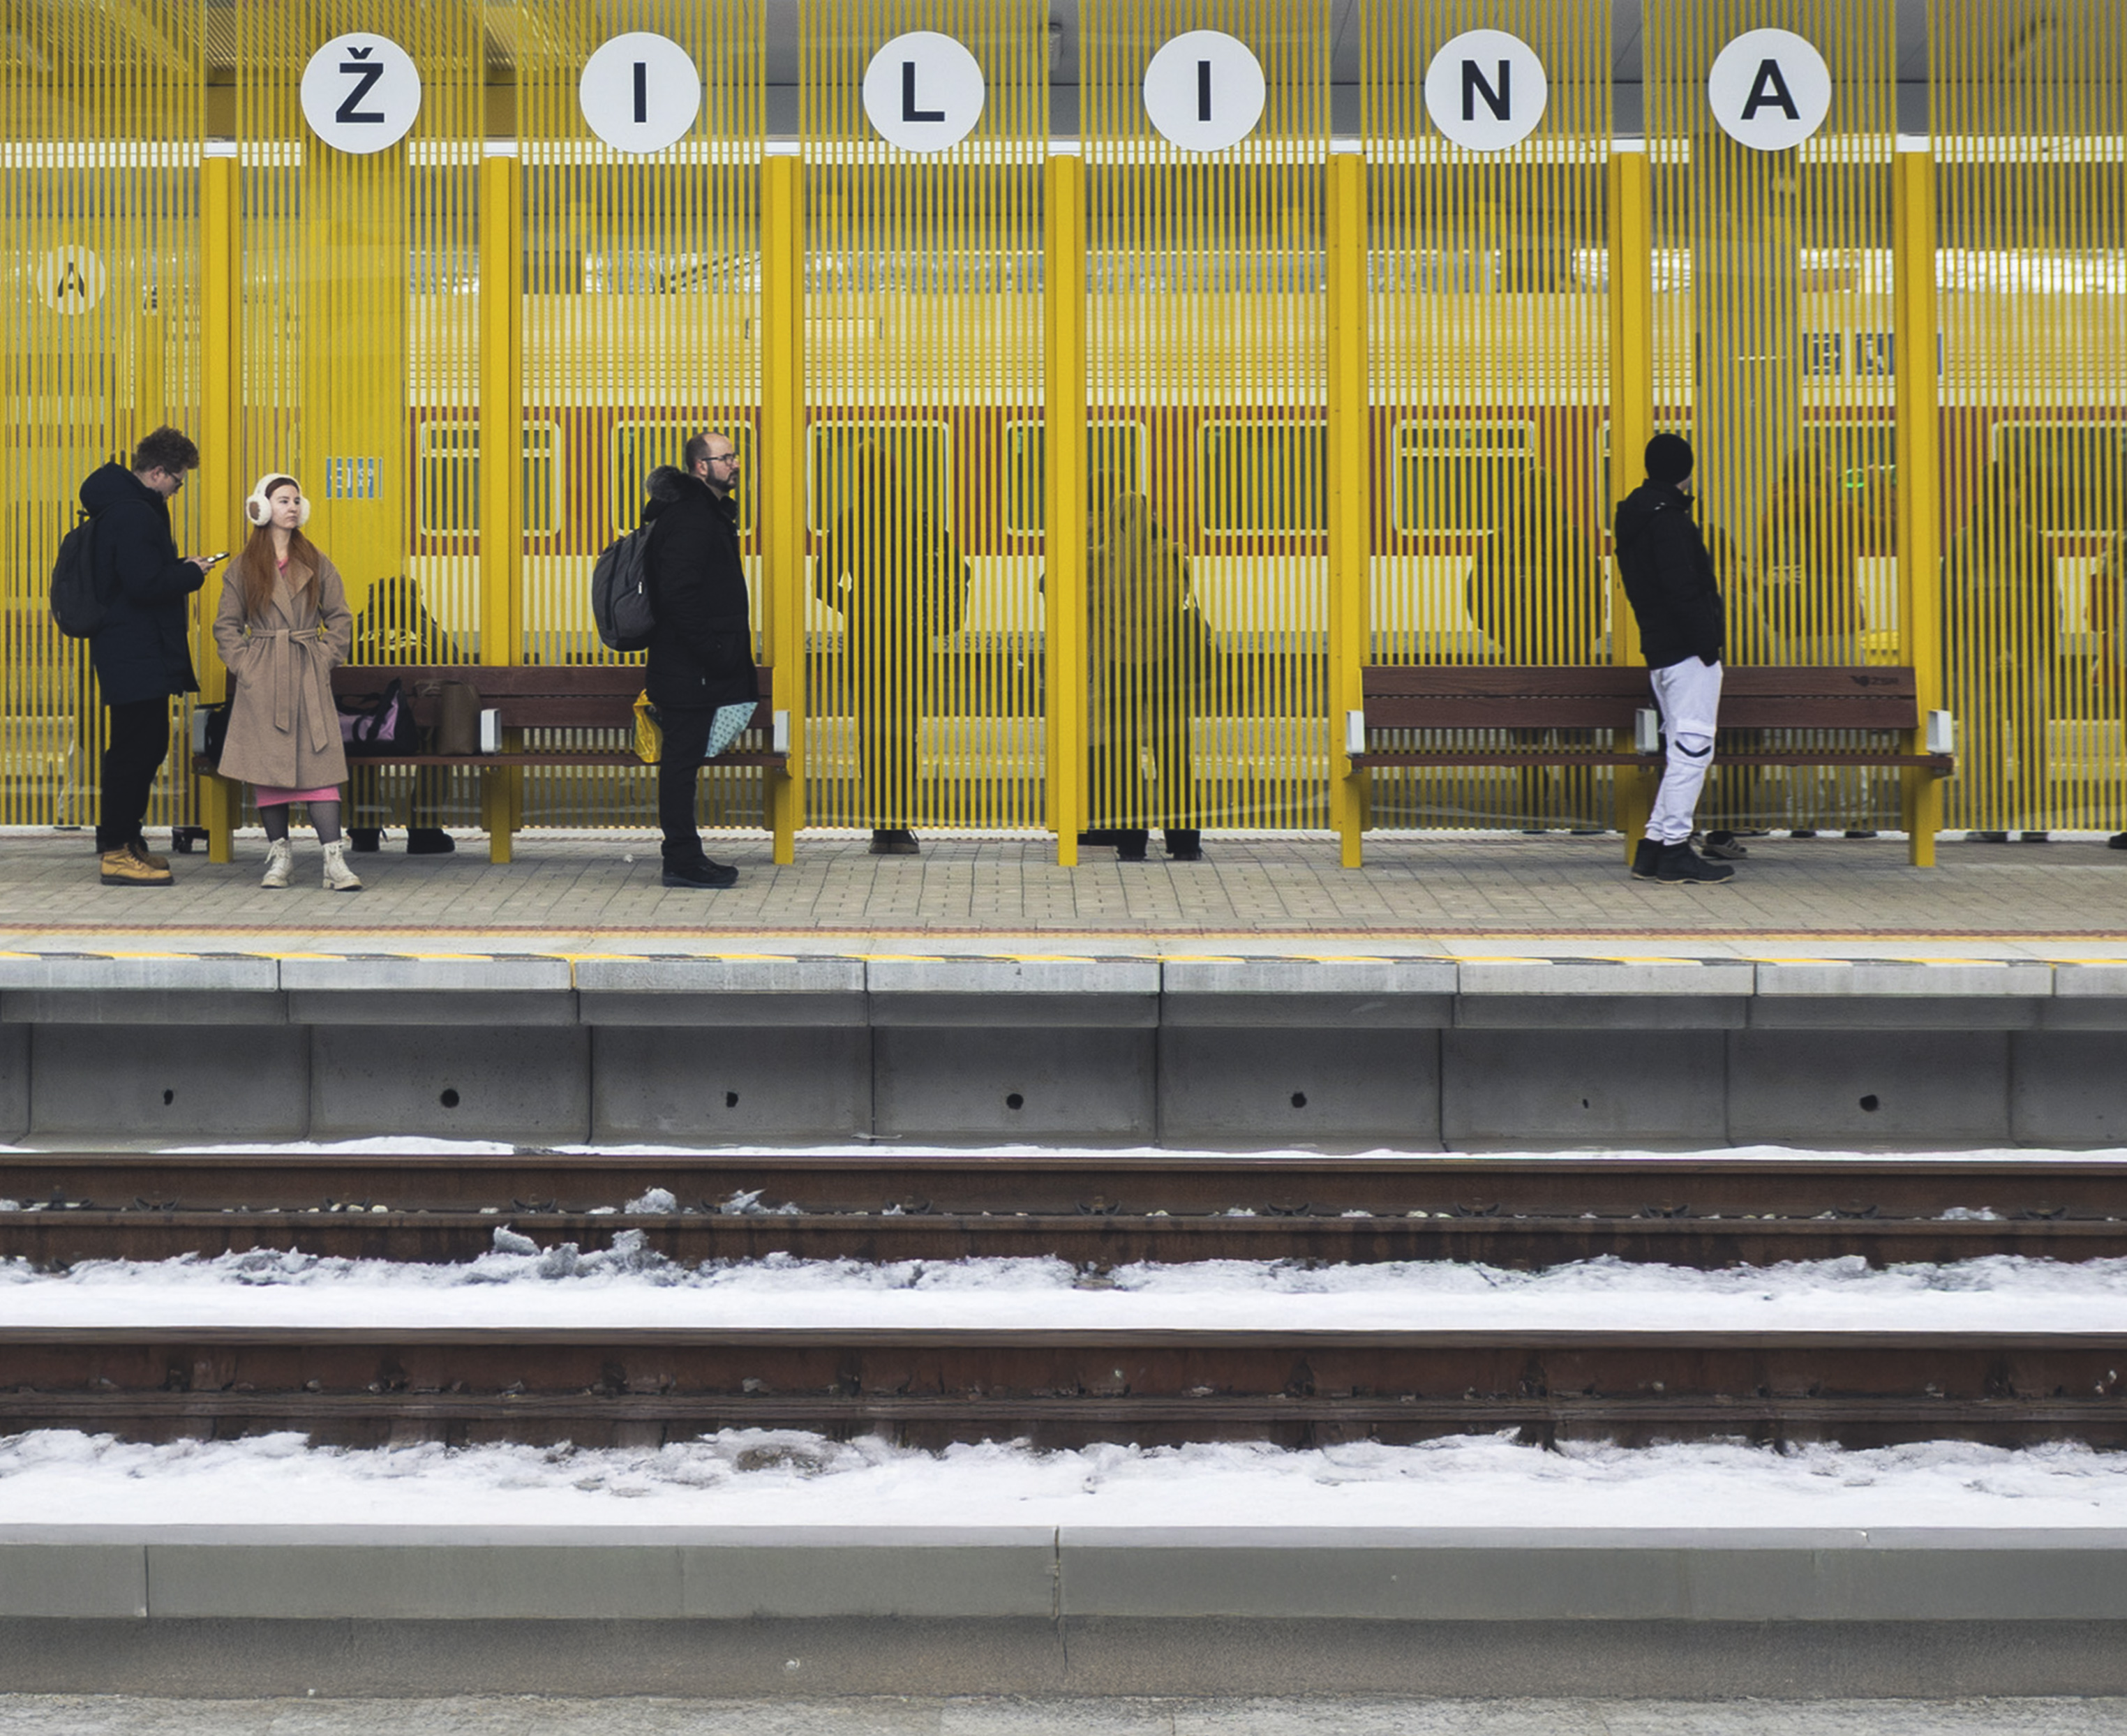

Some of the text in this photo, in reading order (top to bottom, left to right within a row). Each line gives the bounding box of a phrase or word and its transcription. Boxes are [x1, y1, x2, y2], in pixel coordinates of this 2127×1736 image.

[335, 47, 1800, 124] Ž I L I N A
[57, 262, 85, 298] A
